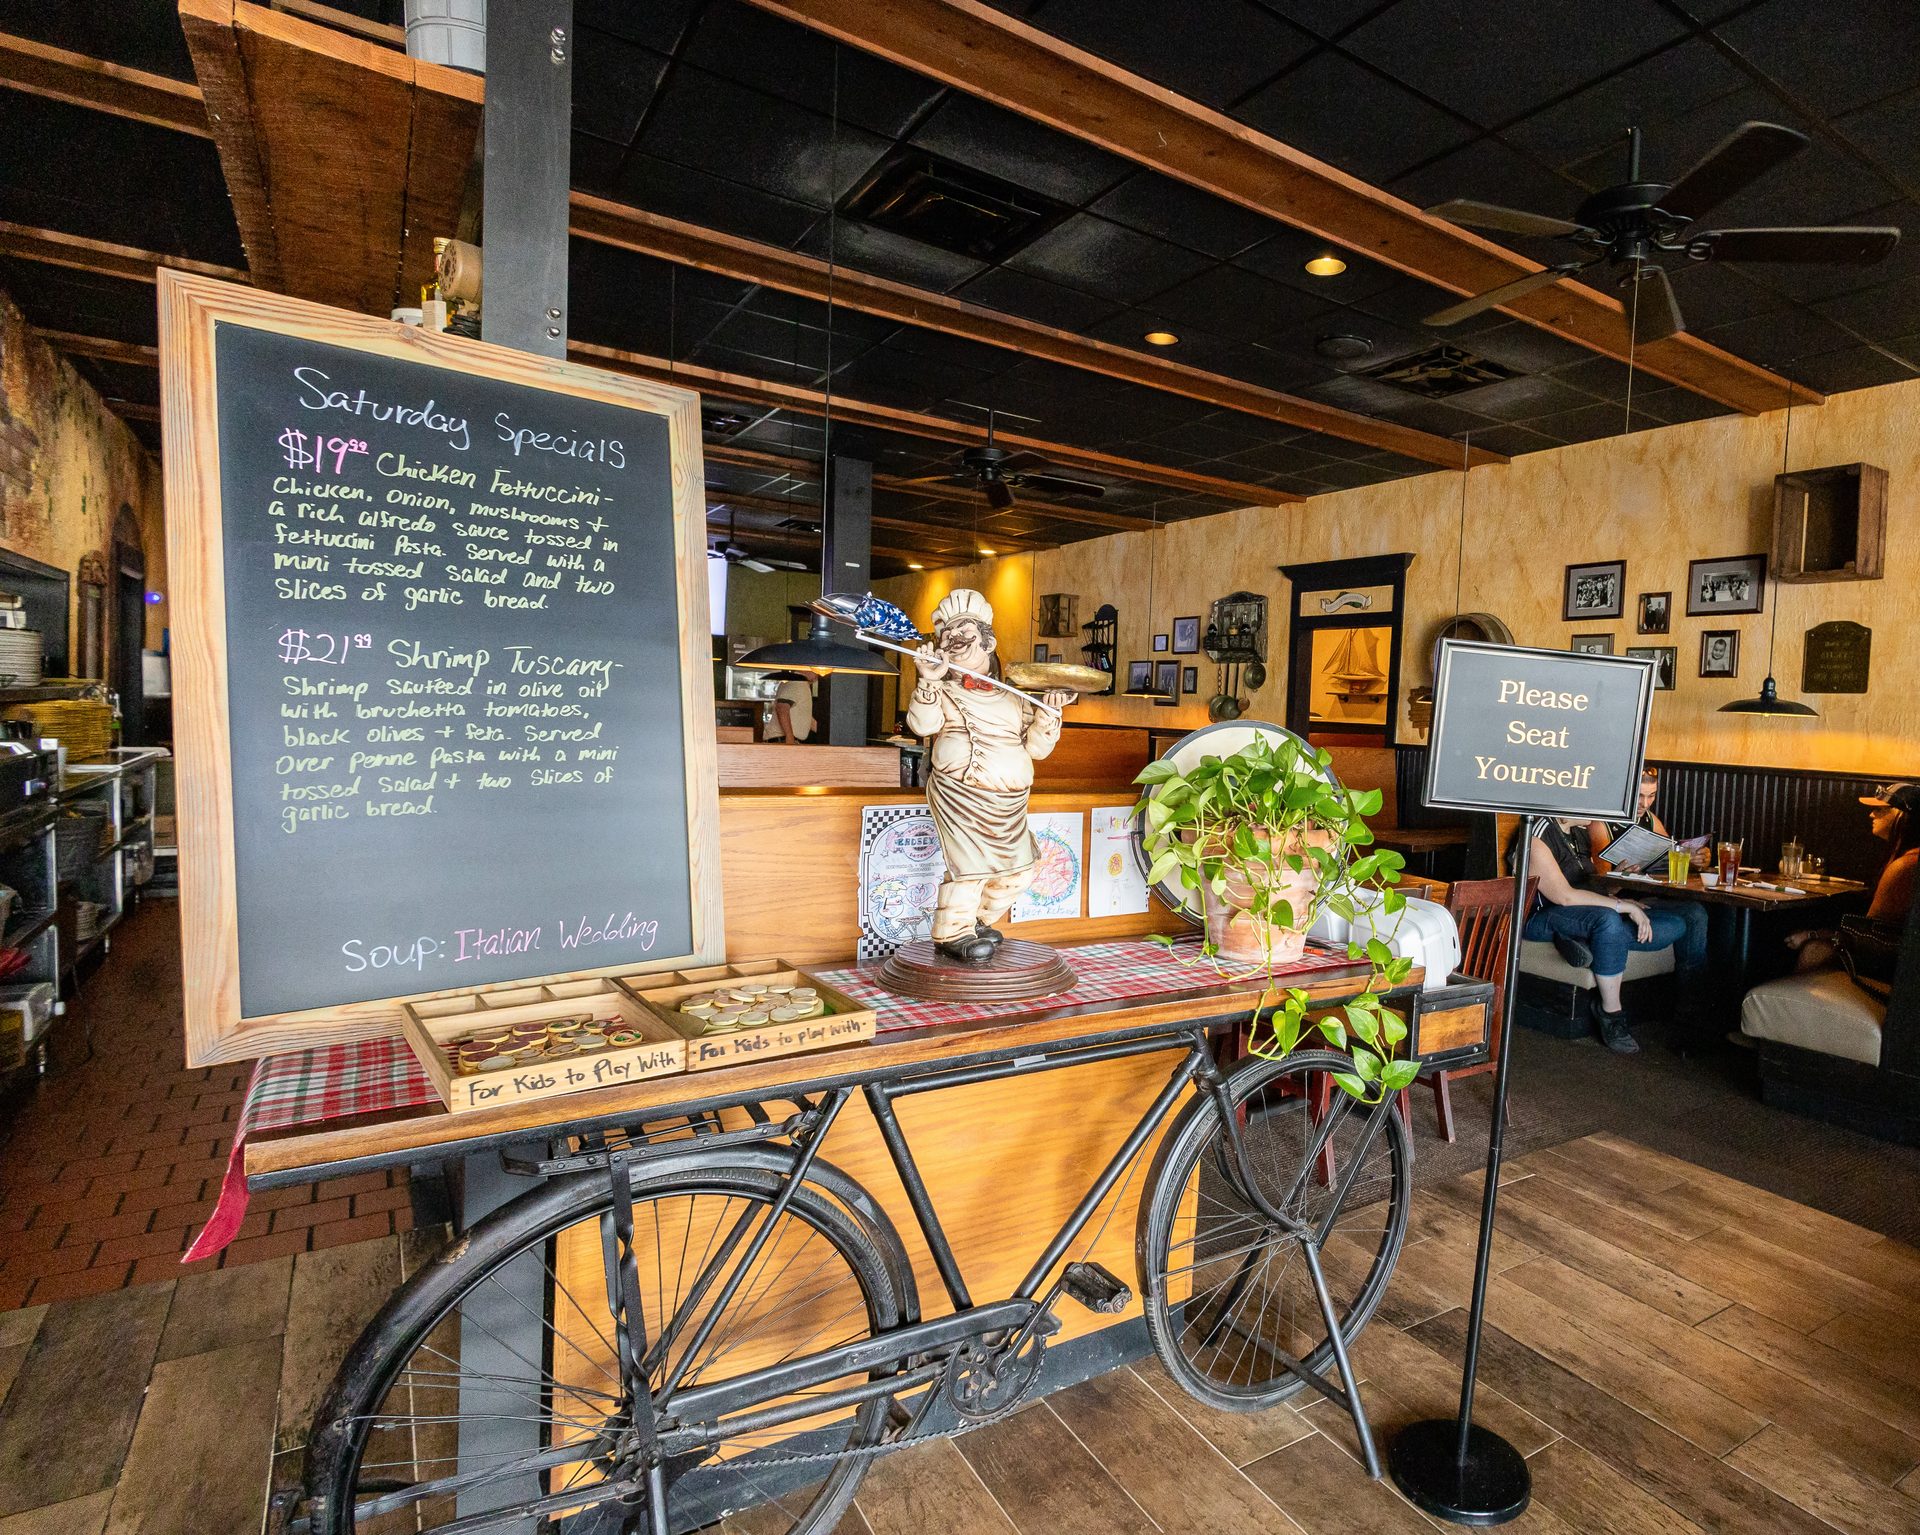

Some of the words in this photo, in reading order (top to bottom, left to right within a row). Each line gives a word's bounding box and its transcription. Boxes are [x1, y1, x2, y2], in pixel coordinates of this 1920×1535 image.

[294, 367, 470, 450] Saturday
[495, 412, 625, 468] Specials
[376, 452, 476, 488] Chicken
[298, 503, 345, 523] rich
[359, 511, 436, 532] alfredo
[452, 522, 509, 540] sauce
[524, 529, 592, 549] tossed
[603, 537, 618, 552] in
[469, 502, 579, 529] mushrooms
[274, 523, 375, 550] fettuccini
[547, 554, 584, 571] with
[593, 559, 605, 572] a
[273, 553, 329, 572] mini
[342, 557, 424, 578] tossed
[522, 572, 561, 589] and
[575, 575, 615, 595] two
[361, 582, 387, 601] of
[404, 587, 463, 610] garlic
[484, 590, 548, 609] bread.
[388, 639, 489, 676] Shrimp
[283, 676, 368, 701] Shrimp
[487, 680, 507, 695] in
[518, 682, 564, 697] olive
[579, 680, 603, 697] oil
[1497, 679, 1589, 711] Please
[356, 701, 466, 719] bruchetta
[283, 725, 350, 746] black
[367, 726, 425, 742] olives
[435, 726, 455, 738] +
[1506, 720, 1570, 749] Seat
[499, 746, 540, 762] with
[555, 750, 566, 762] a
[578, 746, 620, 761] mini
[280, 775, 361, 800] tossed
[477, 772, 511, 790] two
[594, 766, 614, 783] of
[1474, 755, 1595, 789] Yourself
[281, 802, 349, 833] garlic
[453, 926, 542, 962] Italian
[559, 911, 659, 951] Wedding
[734, 1035, 770, 1054] Kids
[778, 1032, 793, 1046] to
[469, 1079, 504, 1106] For
[513, 1074, 557, 1094] Kids
[565, 1068, 585, 1085] to
[592, 1058, 630, 1083] Play
